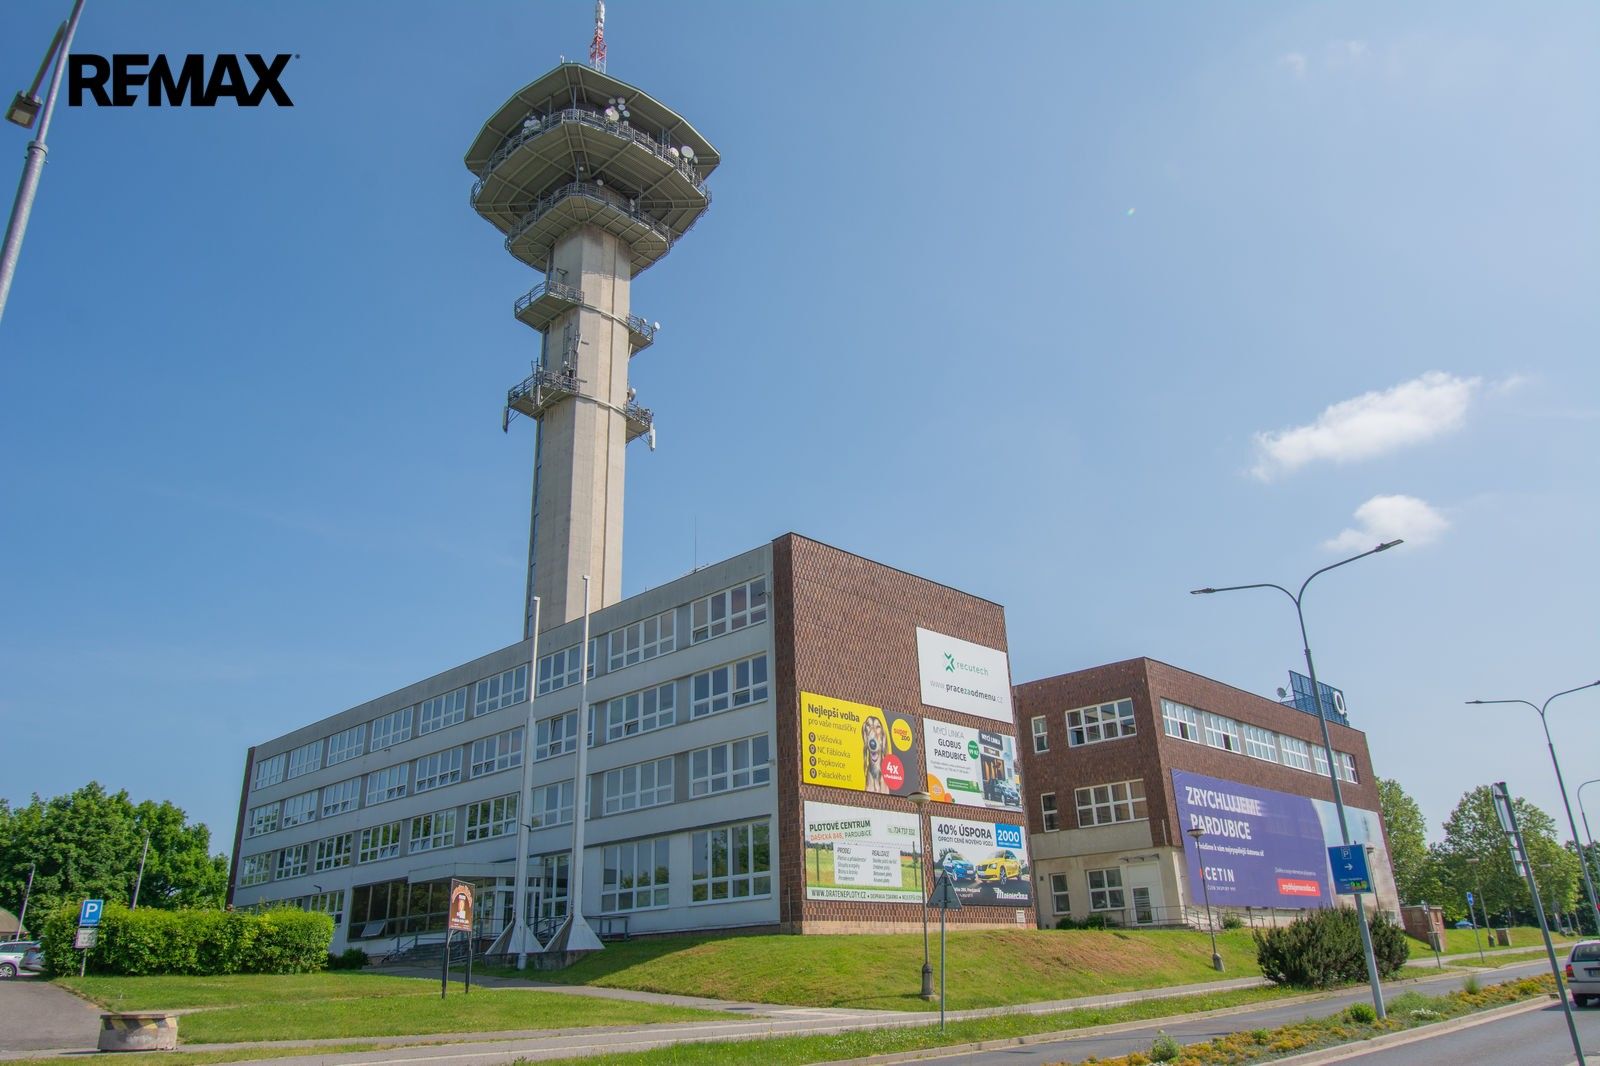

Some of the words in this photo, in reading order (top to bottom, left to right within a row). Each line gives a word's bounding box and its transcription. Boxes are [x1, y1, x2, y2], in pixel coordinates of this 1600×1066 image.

[957, 662, 988, 676] recutech
[808, 703, 839, 719] Nejlepší
[840, 711, 860, 723] volba
[819, 720, 832, 728] vaše
[938, 738, 962, 750] GLOBUS
[934, 748, 967, 762] PARDUBICE
[1185, 786, 1264, 817] ZRYCHLUJEME
[809, 821, 840, 832] PLOTOVÉ
[840, 820, 871, 830] CENTRUM
[938, 824, 958, 836] 40%
[959, 824, 992, 839] ÚSPORA
[998, 830, 1020, 843] 2000
[1190, 813, 1252, 840] PARDUBICE
[1205, 866, 1235, 882] CETIN
[85, 903, 98, 918] P
